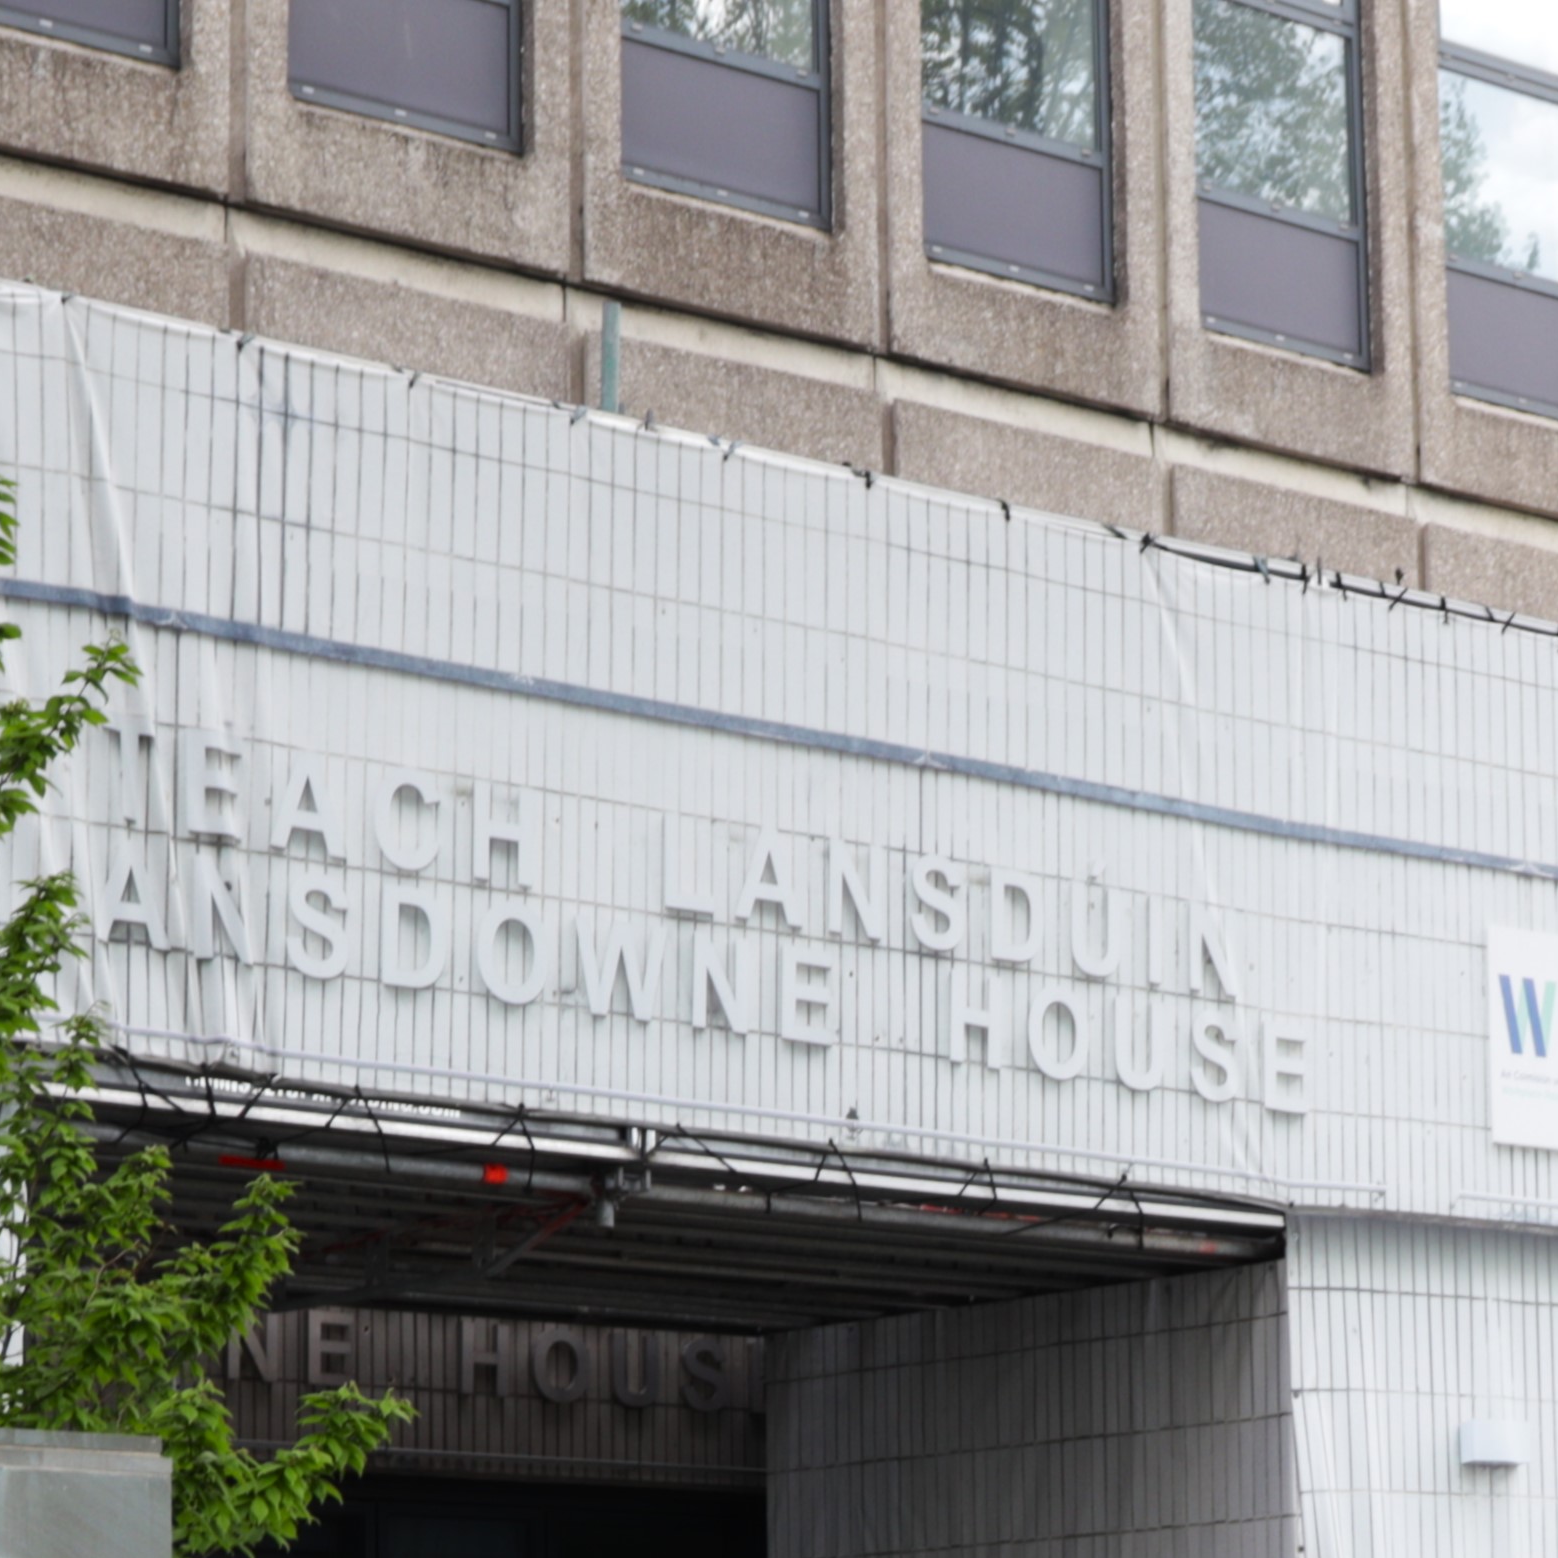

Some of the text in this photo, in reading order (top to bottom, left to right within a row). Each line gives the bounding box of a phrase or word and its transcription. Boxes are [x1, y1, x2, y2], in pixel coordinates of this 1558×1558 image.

[97, 832, 1311, 1115] ANSDOWNE HOUSE
[99, 711, 1238, 999] TEACH LANSDÚIN
